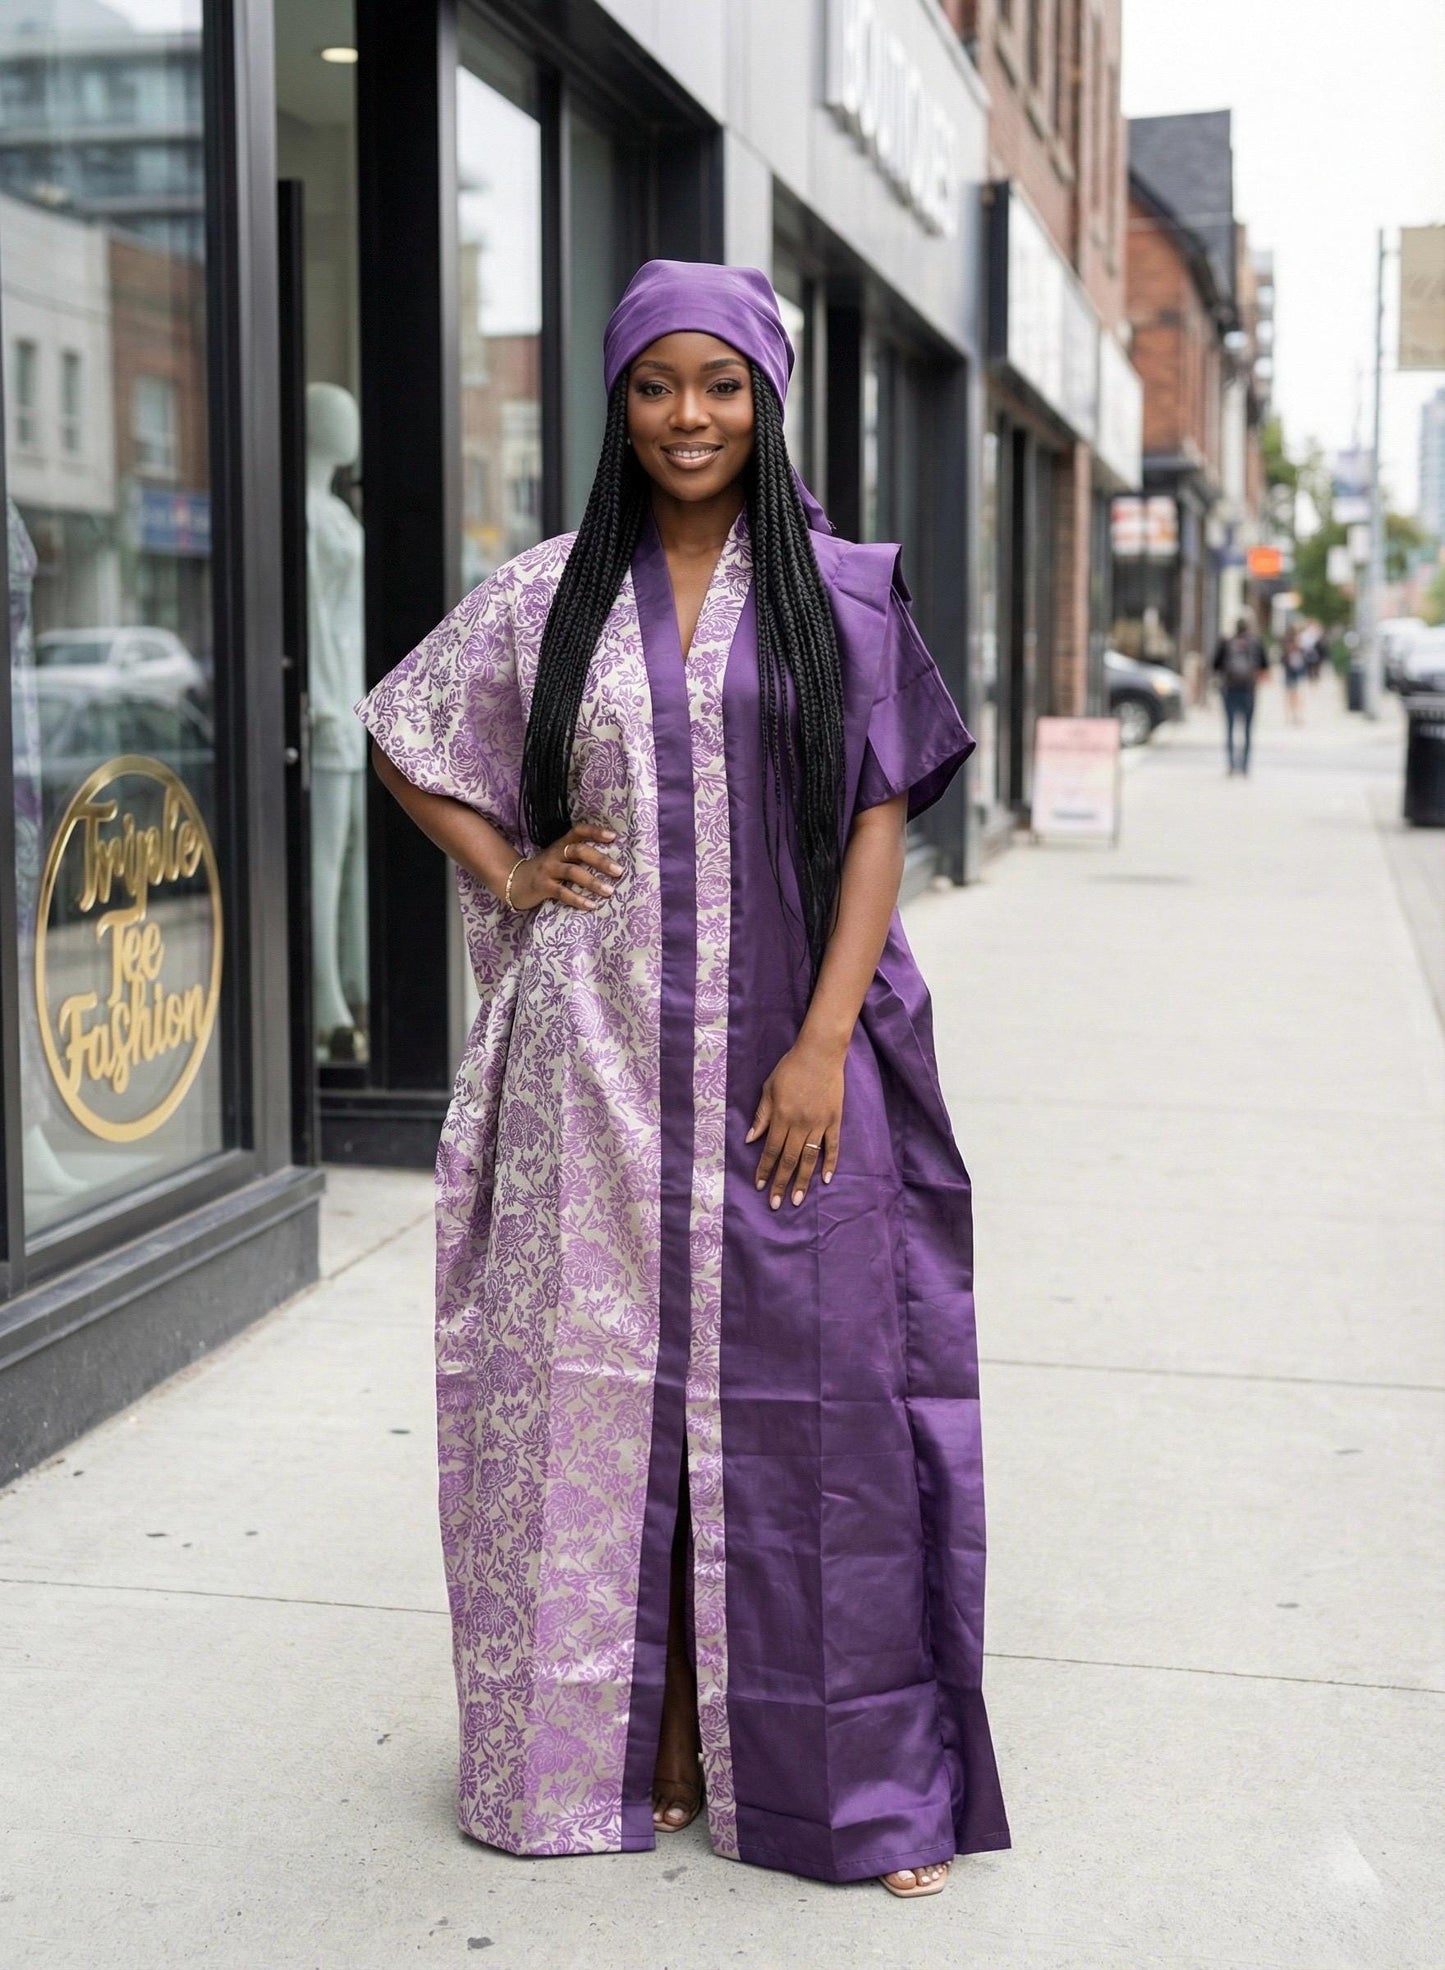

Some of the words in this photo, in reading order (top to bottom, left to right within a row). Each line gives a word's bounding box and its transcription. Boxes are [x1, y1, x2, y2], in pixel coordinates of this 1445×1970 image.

[73, 783, 204, 921] Triple
[96, 907, 164, 1005] Tee
[59, 978, 205, 1094] Fashion
